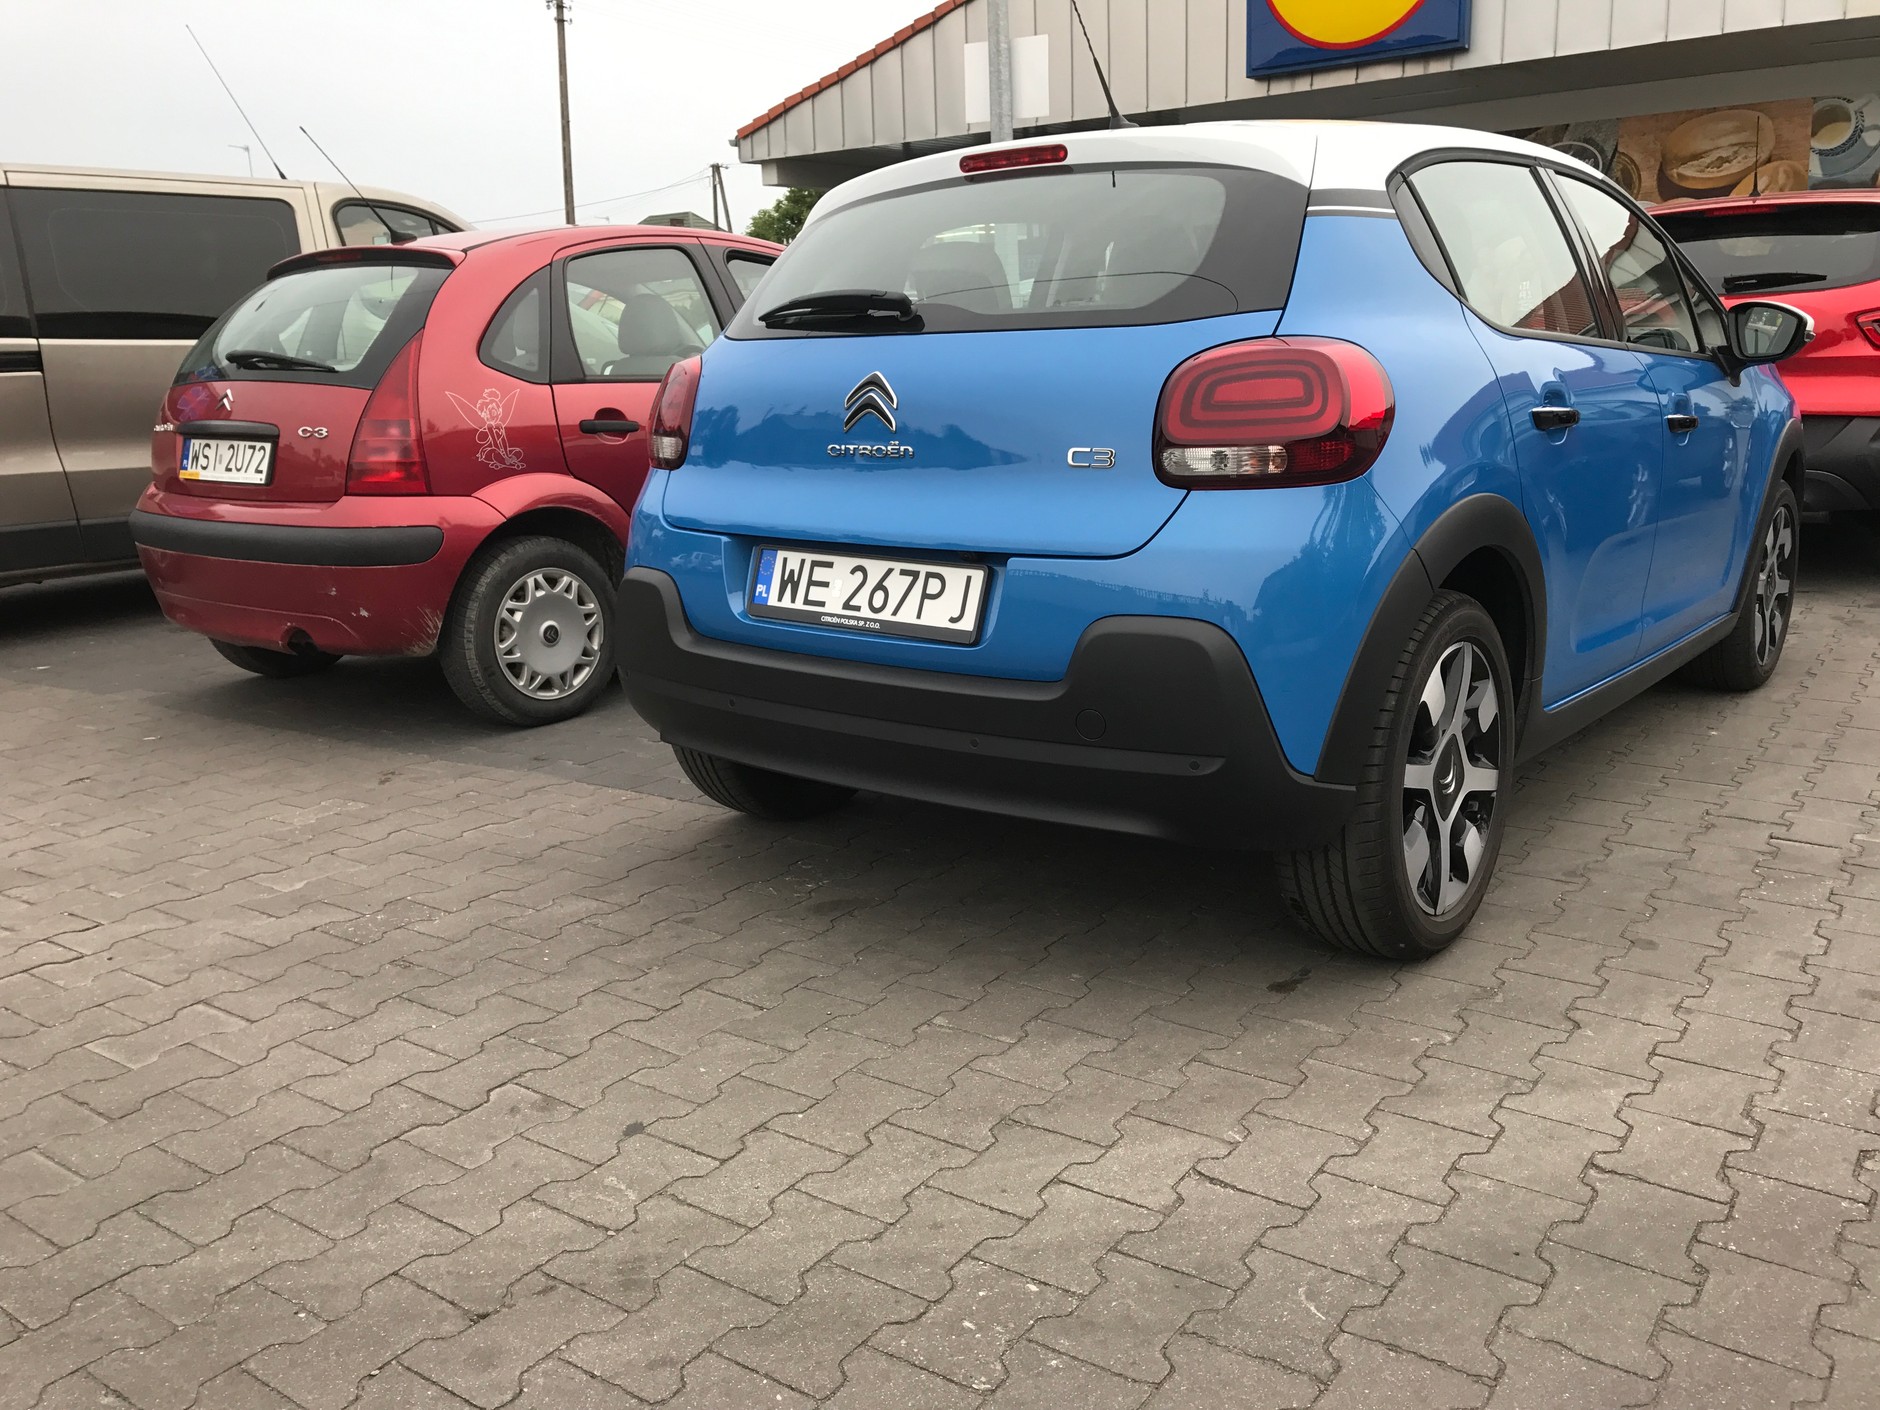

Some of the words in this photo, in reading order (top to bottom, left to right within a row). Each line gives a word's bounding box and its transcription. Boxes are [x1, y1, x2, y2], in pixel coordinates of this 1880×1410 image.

[297, 426, 329, 439] C3
[224, 443, 266, 474] 2U72
[827, 440, 914, 458] CITROËN
[1067, 446, 1116, 468] C3
[755, 584, 768, 597] PL
[777, 556, 835, 608] WE
[841, 564, 972, 624] 267PJ
